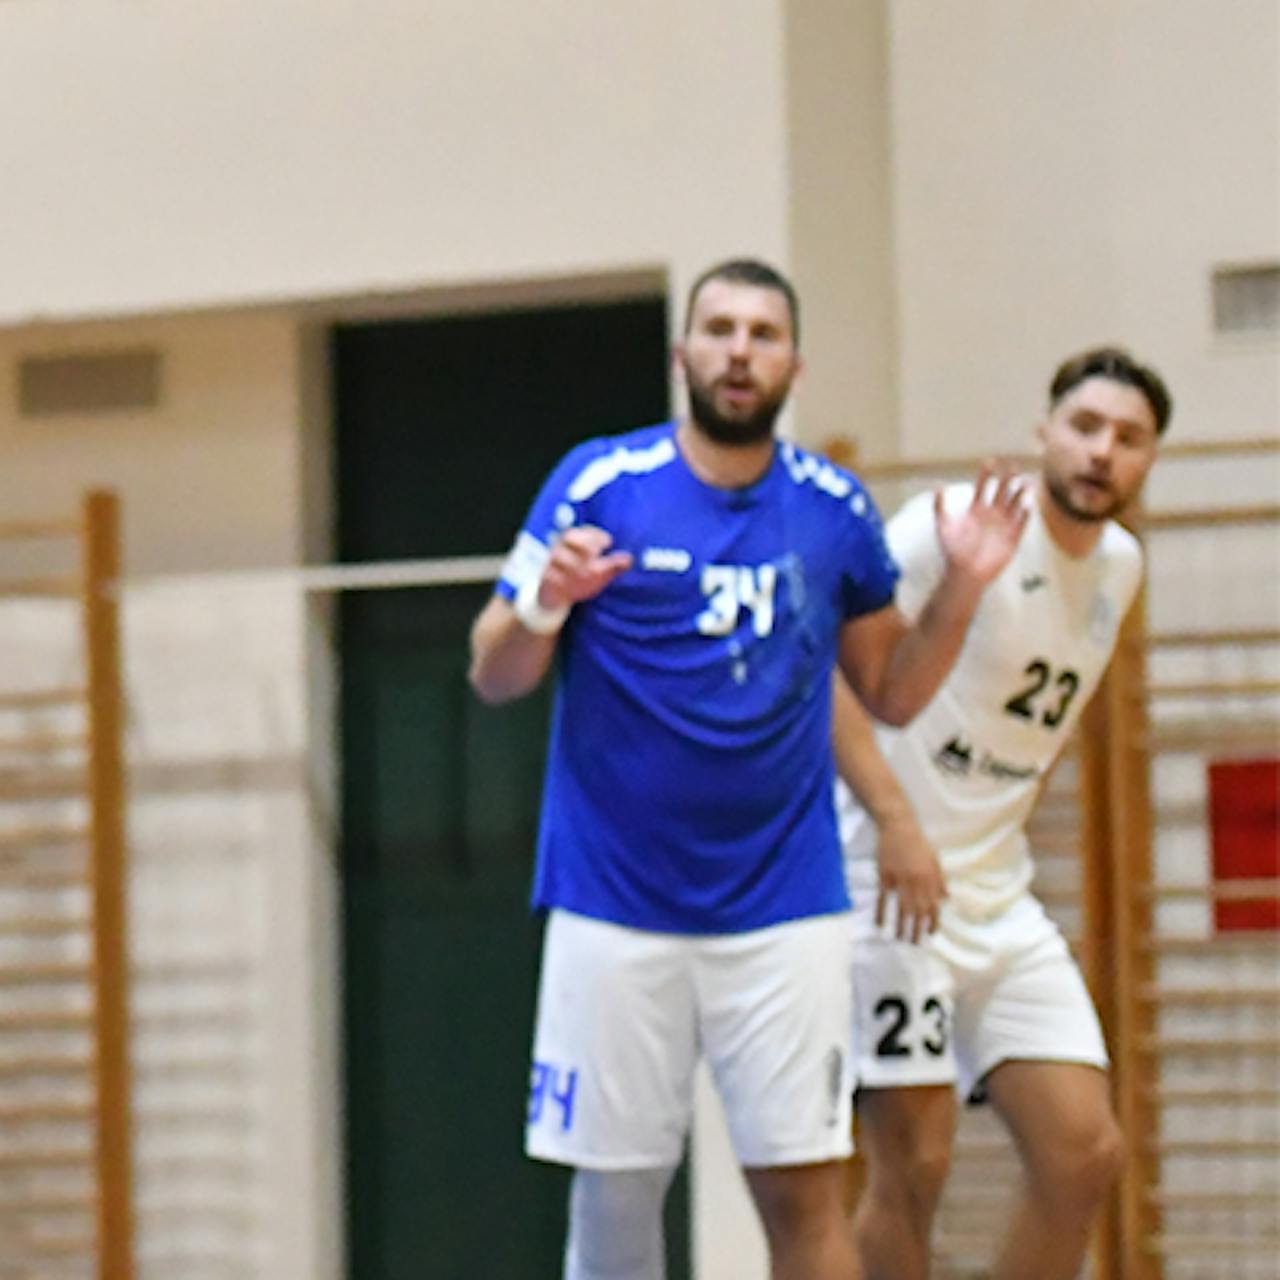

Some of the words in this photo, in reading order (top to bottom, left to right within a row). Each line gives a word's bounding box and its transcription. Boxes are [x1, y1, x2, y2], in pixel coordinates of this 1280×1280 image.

[697, 563, 777, 638] 34
[1003, 658, 1079, 728] 23
[874, 996, 947, 1057] 23
